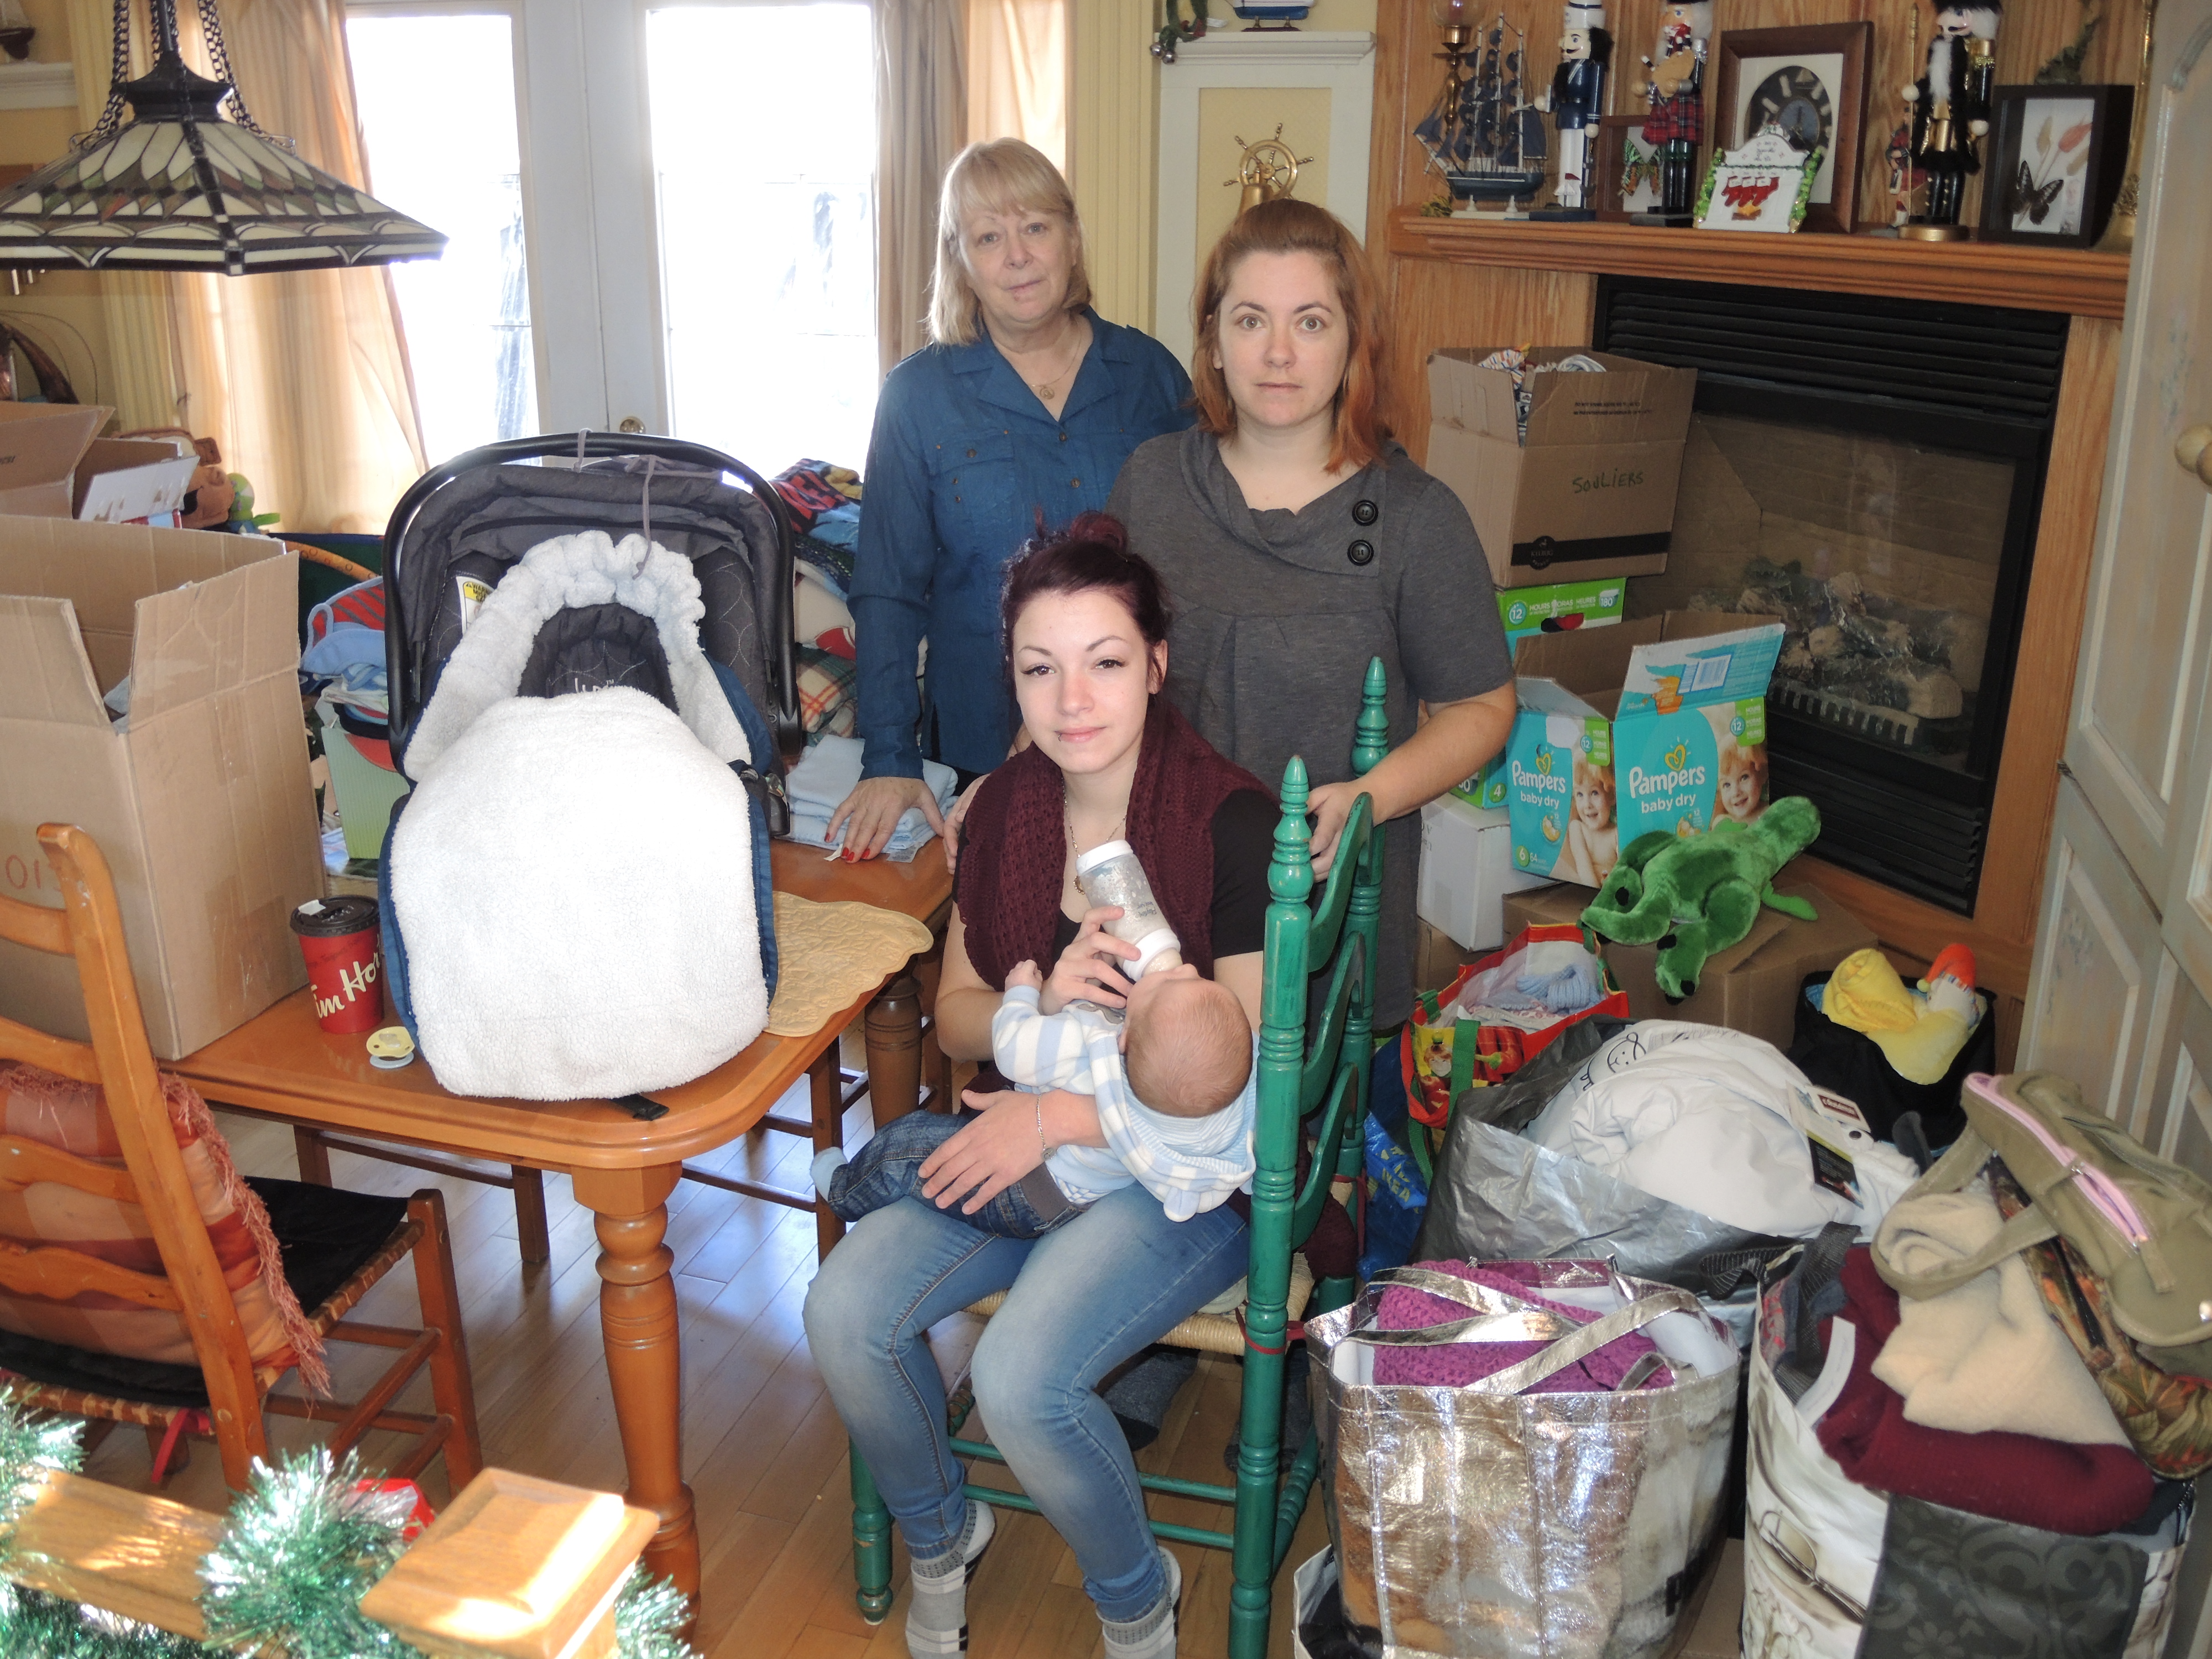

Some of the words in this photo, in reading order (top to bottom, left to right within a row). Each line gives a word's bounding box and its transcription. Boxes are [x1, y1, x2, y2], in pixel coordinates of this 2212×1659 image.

[1572, 468, 1644, 493] SOULIERS
[1530, 602, 1550, 611] HOURS
[1600, 597, 1613, 607] 180
[1511, 609, 1522, 619] 12
[1733, 721, 1742, 731] 12
[1583, 739, 1590, 749] 12
[1512, 760, 1566, 794] Pampers
[1629, 766, 1705, 799] Pampers
[1494, 785, 1501, 797] 4
[1520, 791, 1542, 807] baby
[1544, 795, 1559, 810] dry
[1641, 798, 1673, 814] baby
[1675, 793, 1696, 807] dry
[1520, 848, 1526, 860] 6
[1530, 852, 1537, 863] 64
